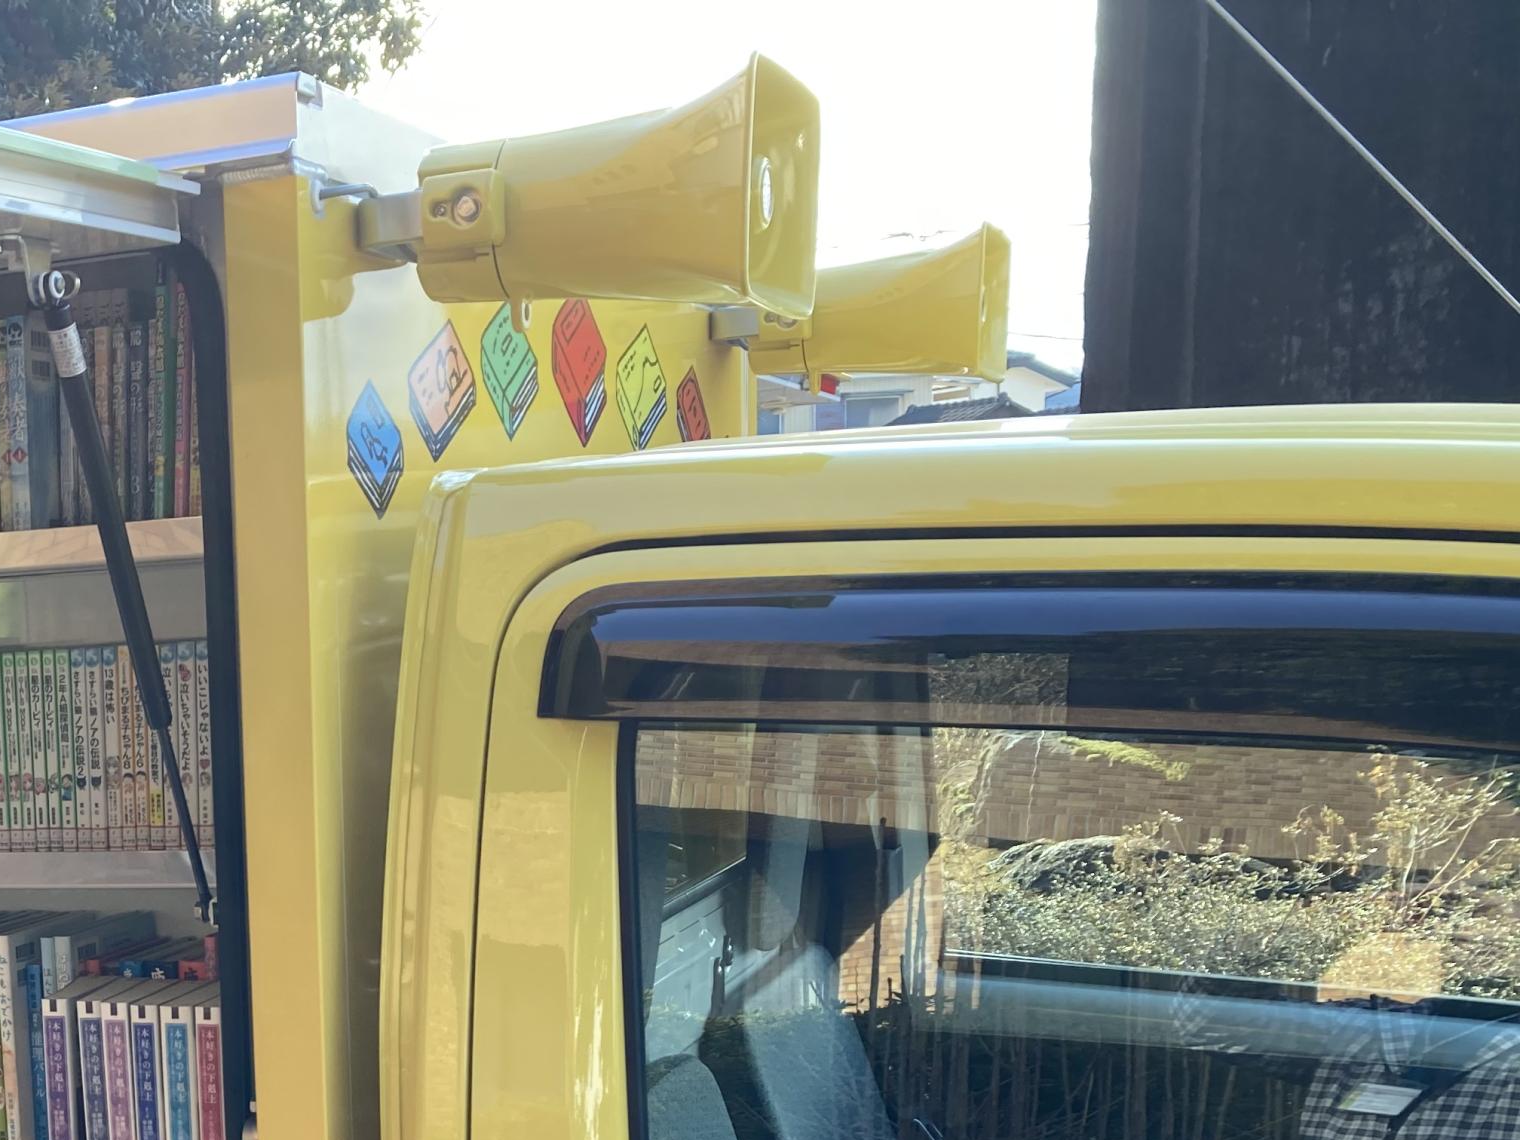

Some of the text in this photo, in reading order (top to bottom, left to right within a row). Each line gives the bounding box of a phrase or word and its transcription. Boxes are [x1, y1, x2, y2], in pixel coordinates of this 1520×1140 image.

[10, 358, 27, 443] 獣の奏者
[31, 675, 42, 728] 星のカービィ
[44, 674, 54, 728] 星のカービィ
[88, 670, 101, 770] さすらい猫ノアの伝説
[104, 668, 115, 725] 13歳は怖い
[121, 686, 131, 769] ちびまる子ちゃん8
[179, 683, 191, 771] 泣いちゃいそうだよ
[197, 664, 209, 756] いいこじゃないよ
[51, 1021, 65, 1094] 本好きの下剋上
[88, 1022, 101, 1096] 本好きの下剋上
[112, 1024, 125, 1099] 本好きの下剋上
[140, 1028, 153, 1102] 本好きの下剋上
[174, 1029, 187, 1103] 本好きの下剋上
[206, 1030, 217, 1105] 本好きの下剋上
